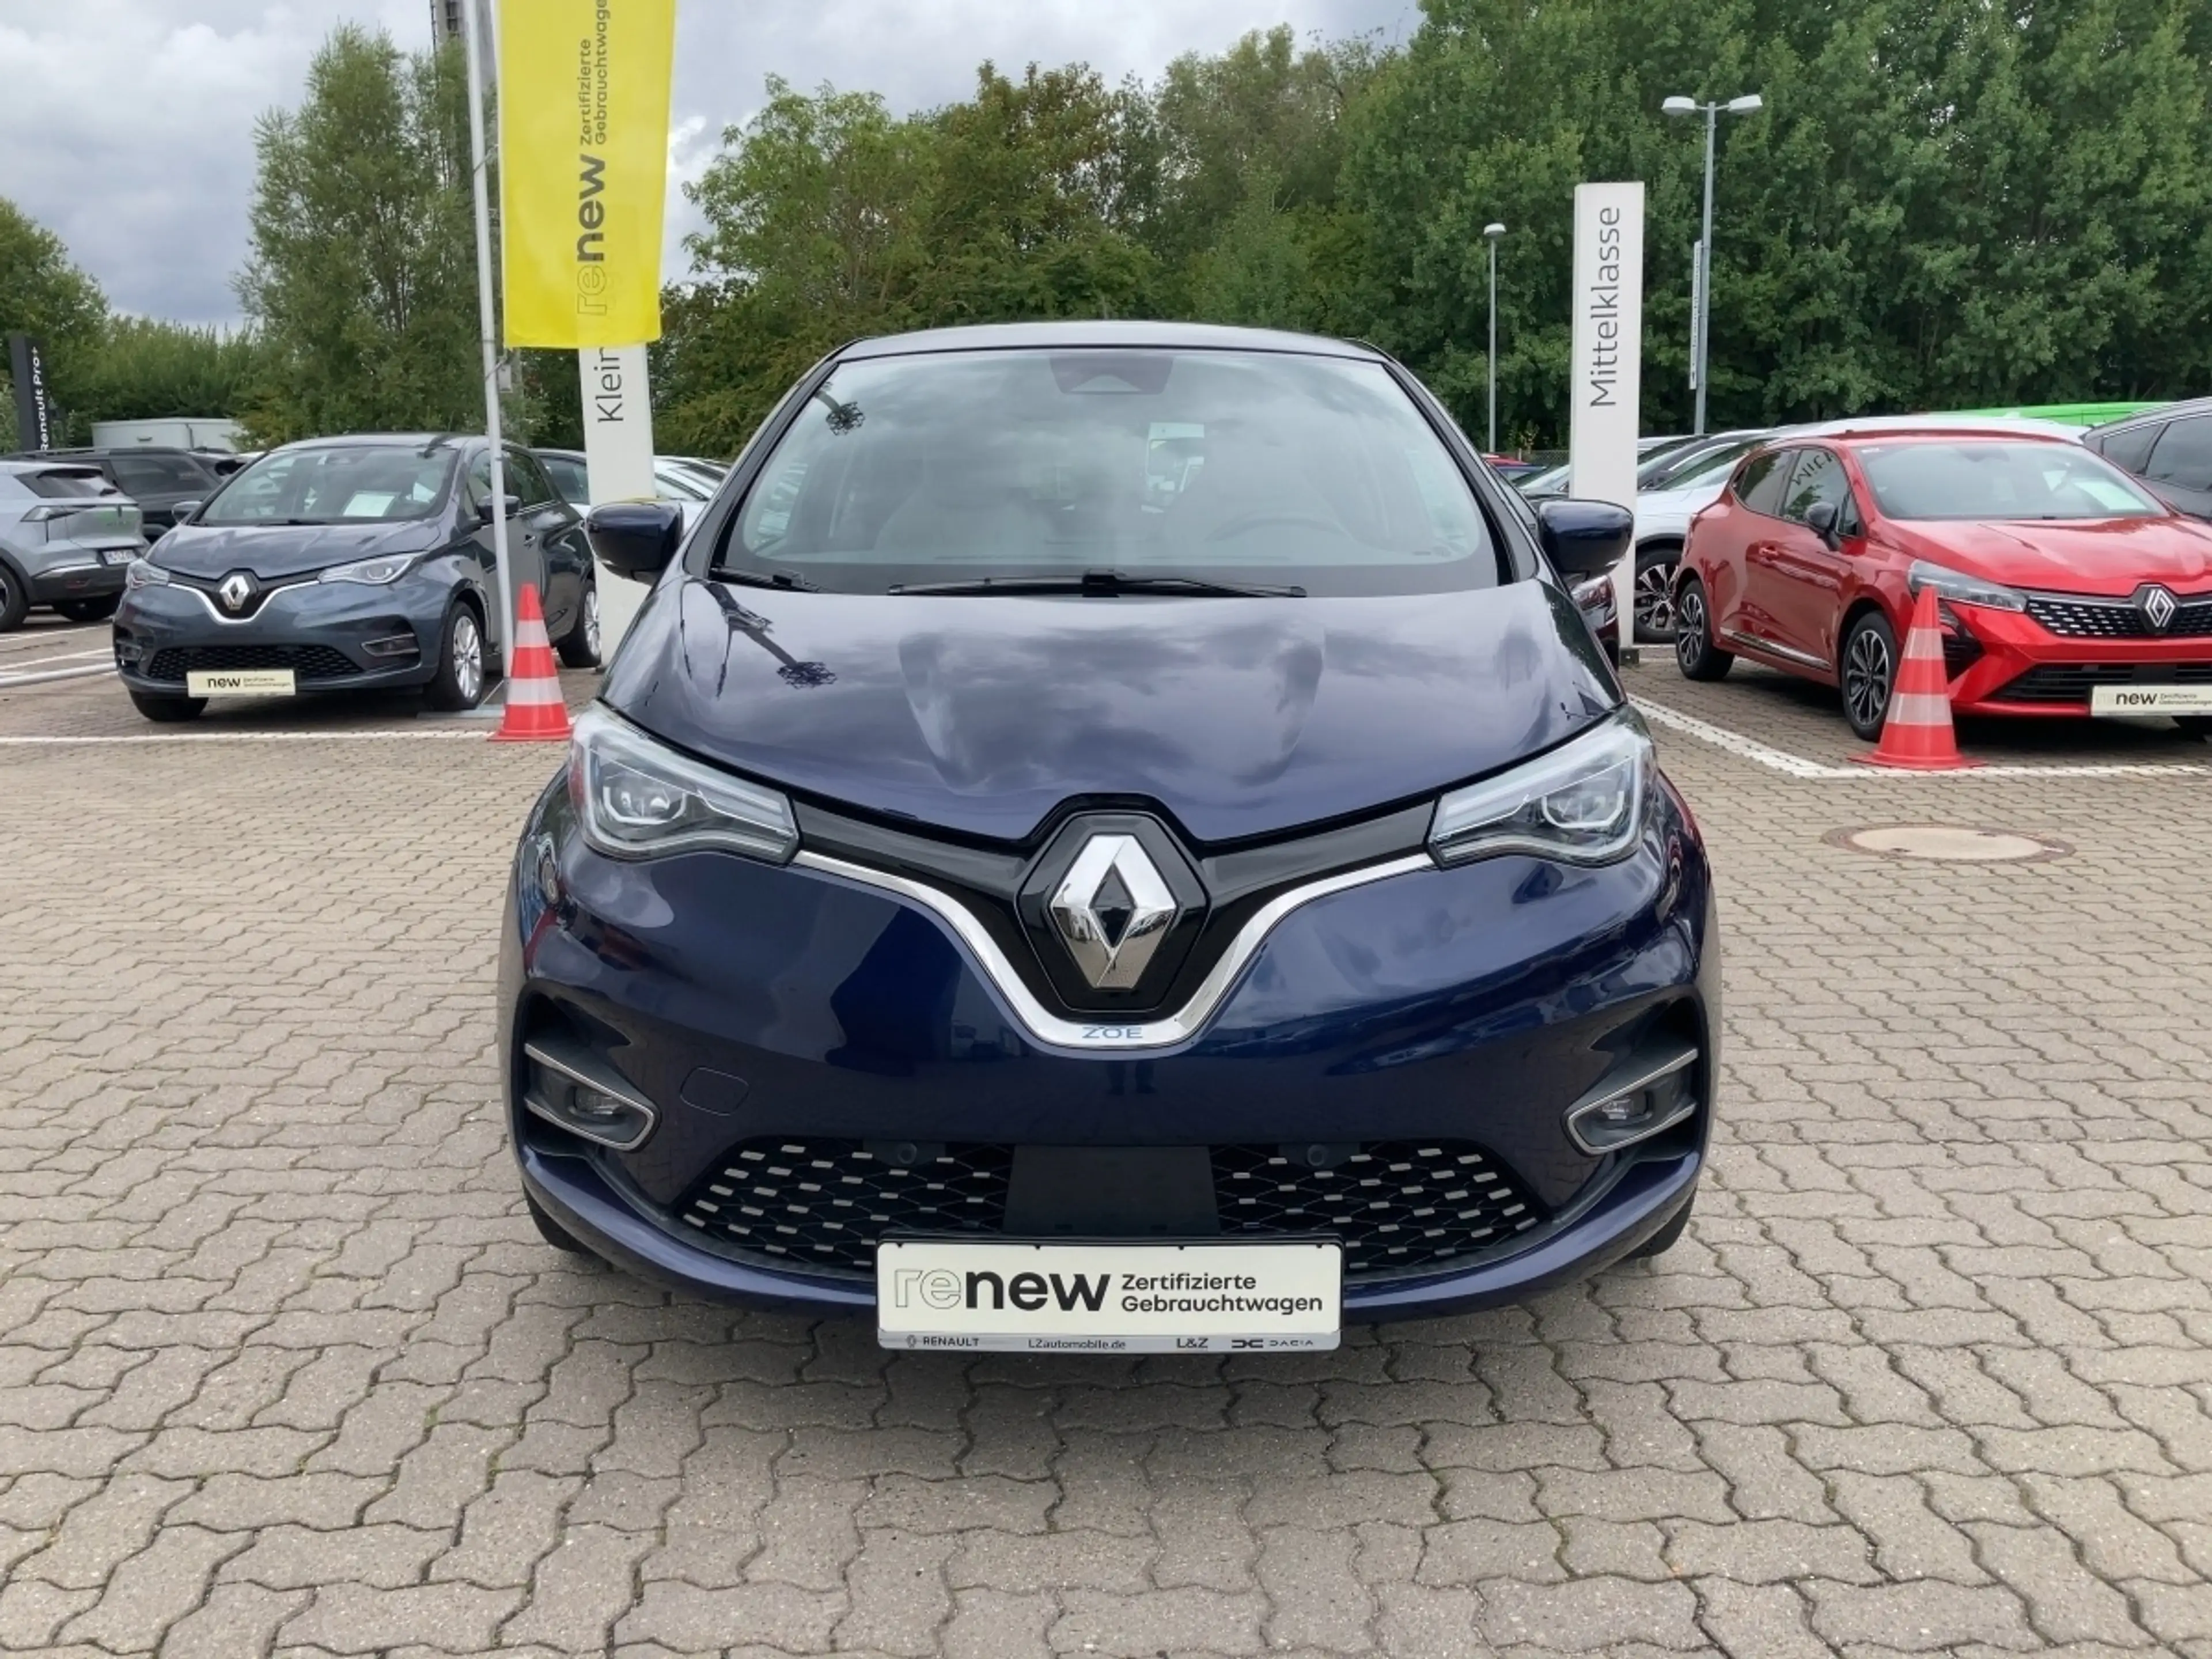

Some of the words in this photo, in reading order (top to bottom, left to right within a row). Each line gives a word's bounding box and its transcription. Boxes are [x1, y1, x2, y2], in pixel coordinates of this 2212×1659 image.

[577, 39, 592, 146] Zertifizierte
[577, 153, 607, 316] renew
[1590, 207, 1620, 407] Mittelklasse
[32, 346, 42, 385] Pro+
[35, 388, 49, 451] Renault
[895, 1268, 1112, 1312] renew
[1121, 1272, 1257, 1291] Zertifizierte
[1121, 1294, 1323, 1316] Gebrauchtwagen
[923, 1336, 979, 1347] RENAULT
[1028, 1339, 1126, 1350] LZautomobile.de
[1176, 1338, 1209, 1349] L&Z
